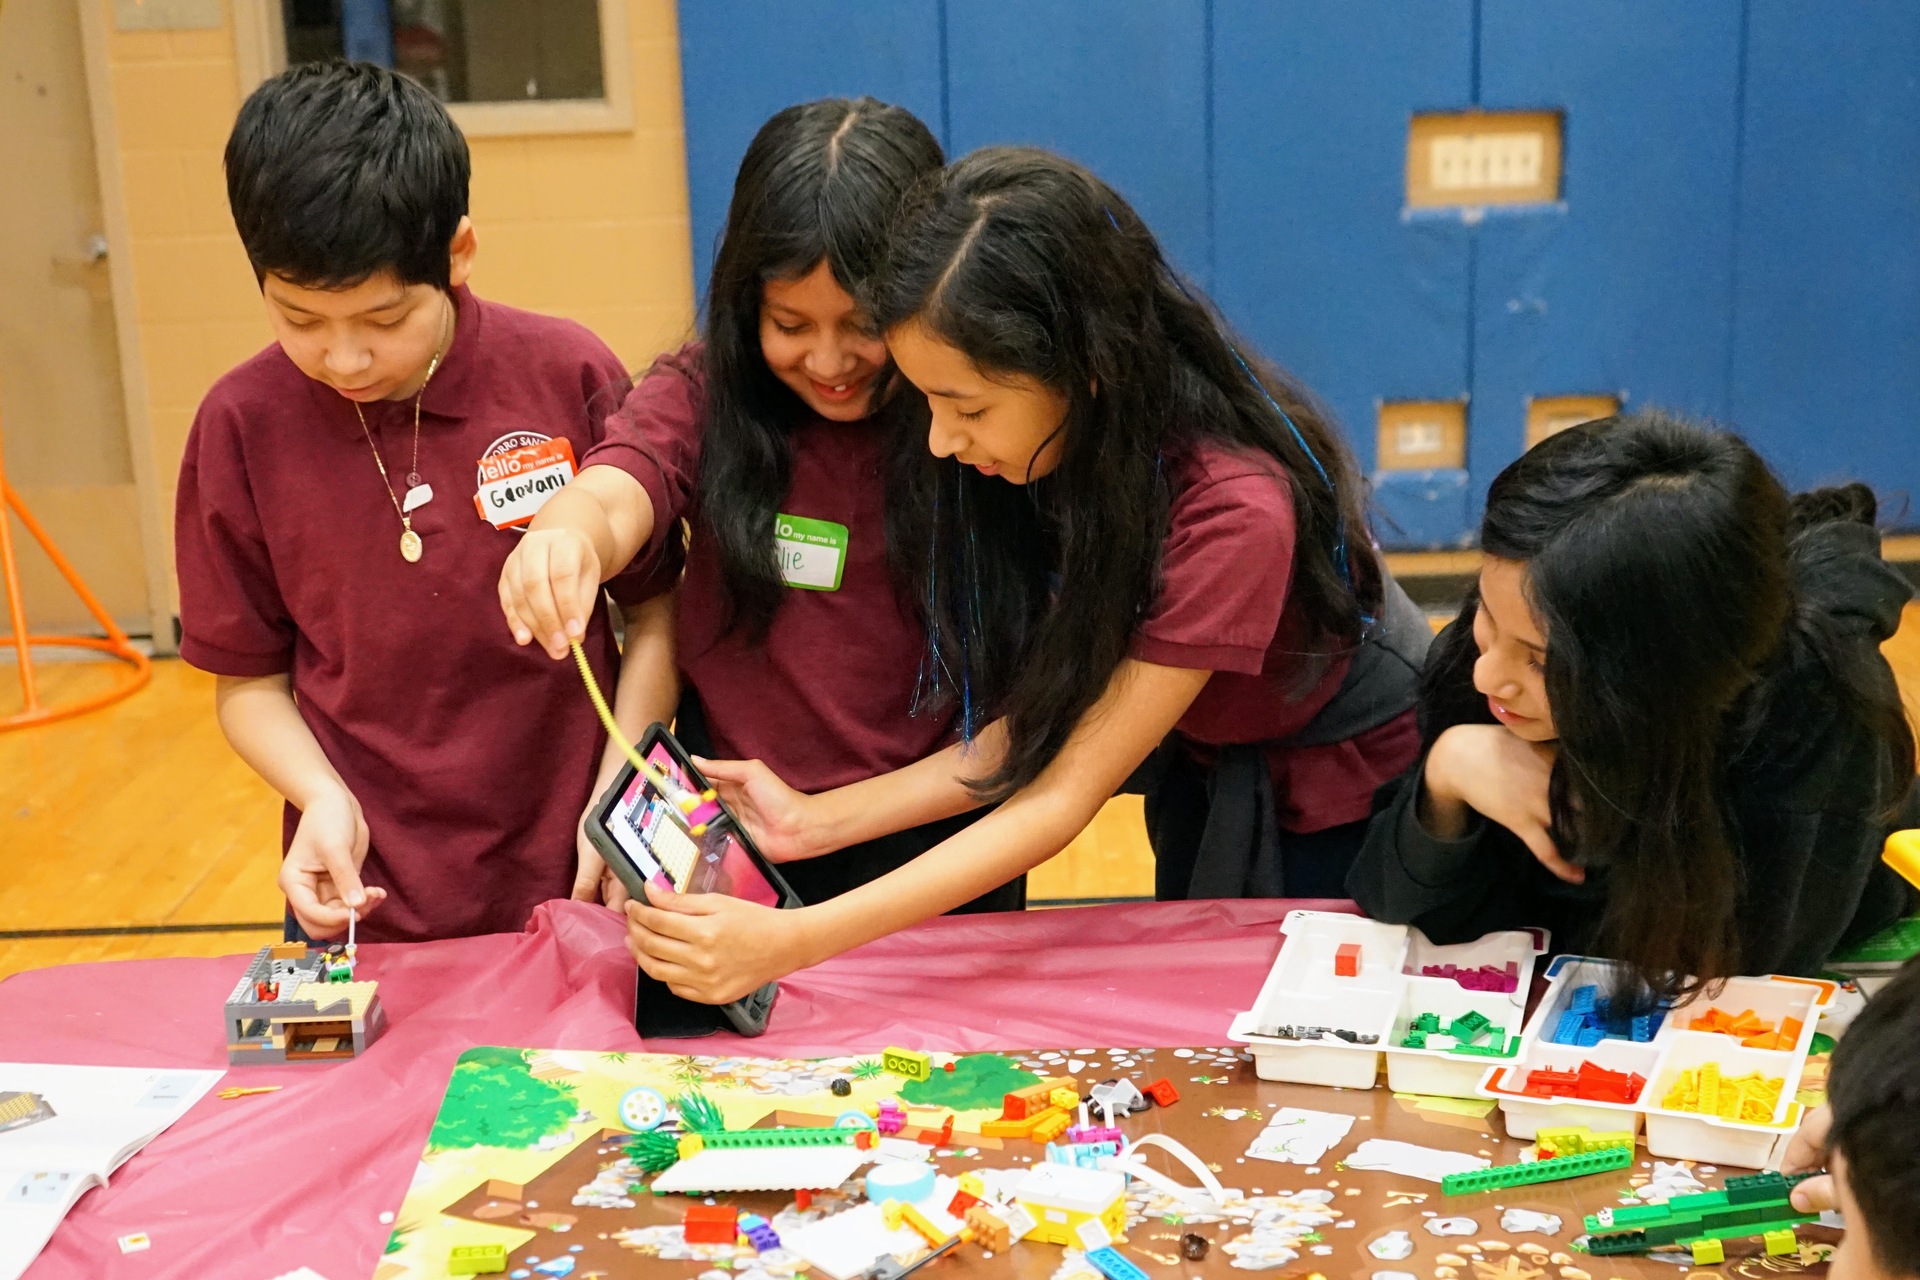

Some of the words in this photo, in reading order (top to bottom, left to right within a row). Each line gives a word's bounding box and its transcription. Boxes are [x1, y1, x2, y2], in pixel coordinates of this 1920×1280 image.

[492, 438, 518, 456] ORRO
[520, 436, 546, 446] SAN
[522, 462, 534, 470] my
[536, 456, 556, 466] name
[793, 532, 806, 540] my
[806, 534, 828, 544] name
[830, 537, 836, 545] is
[781, 546, 805, 571] lie
